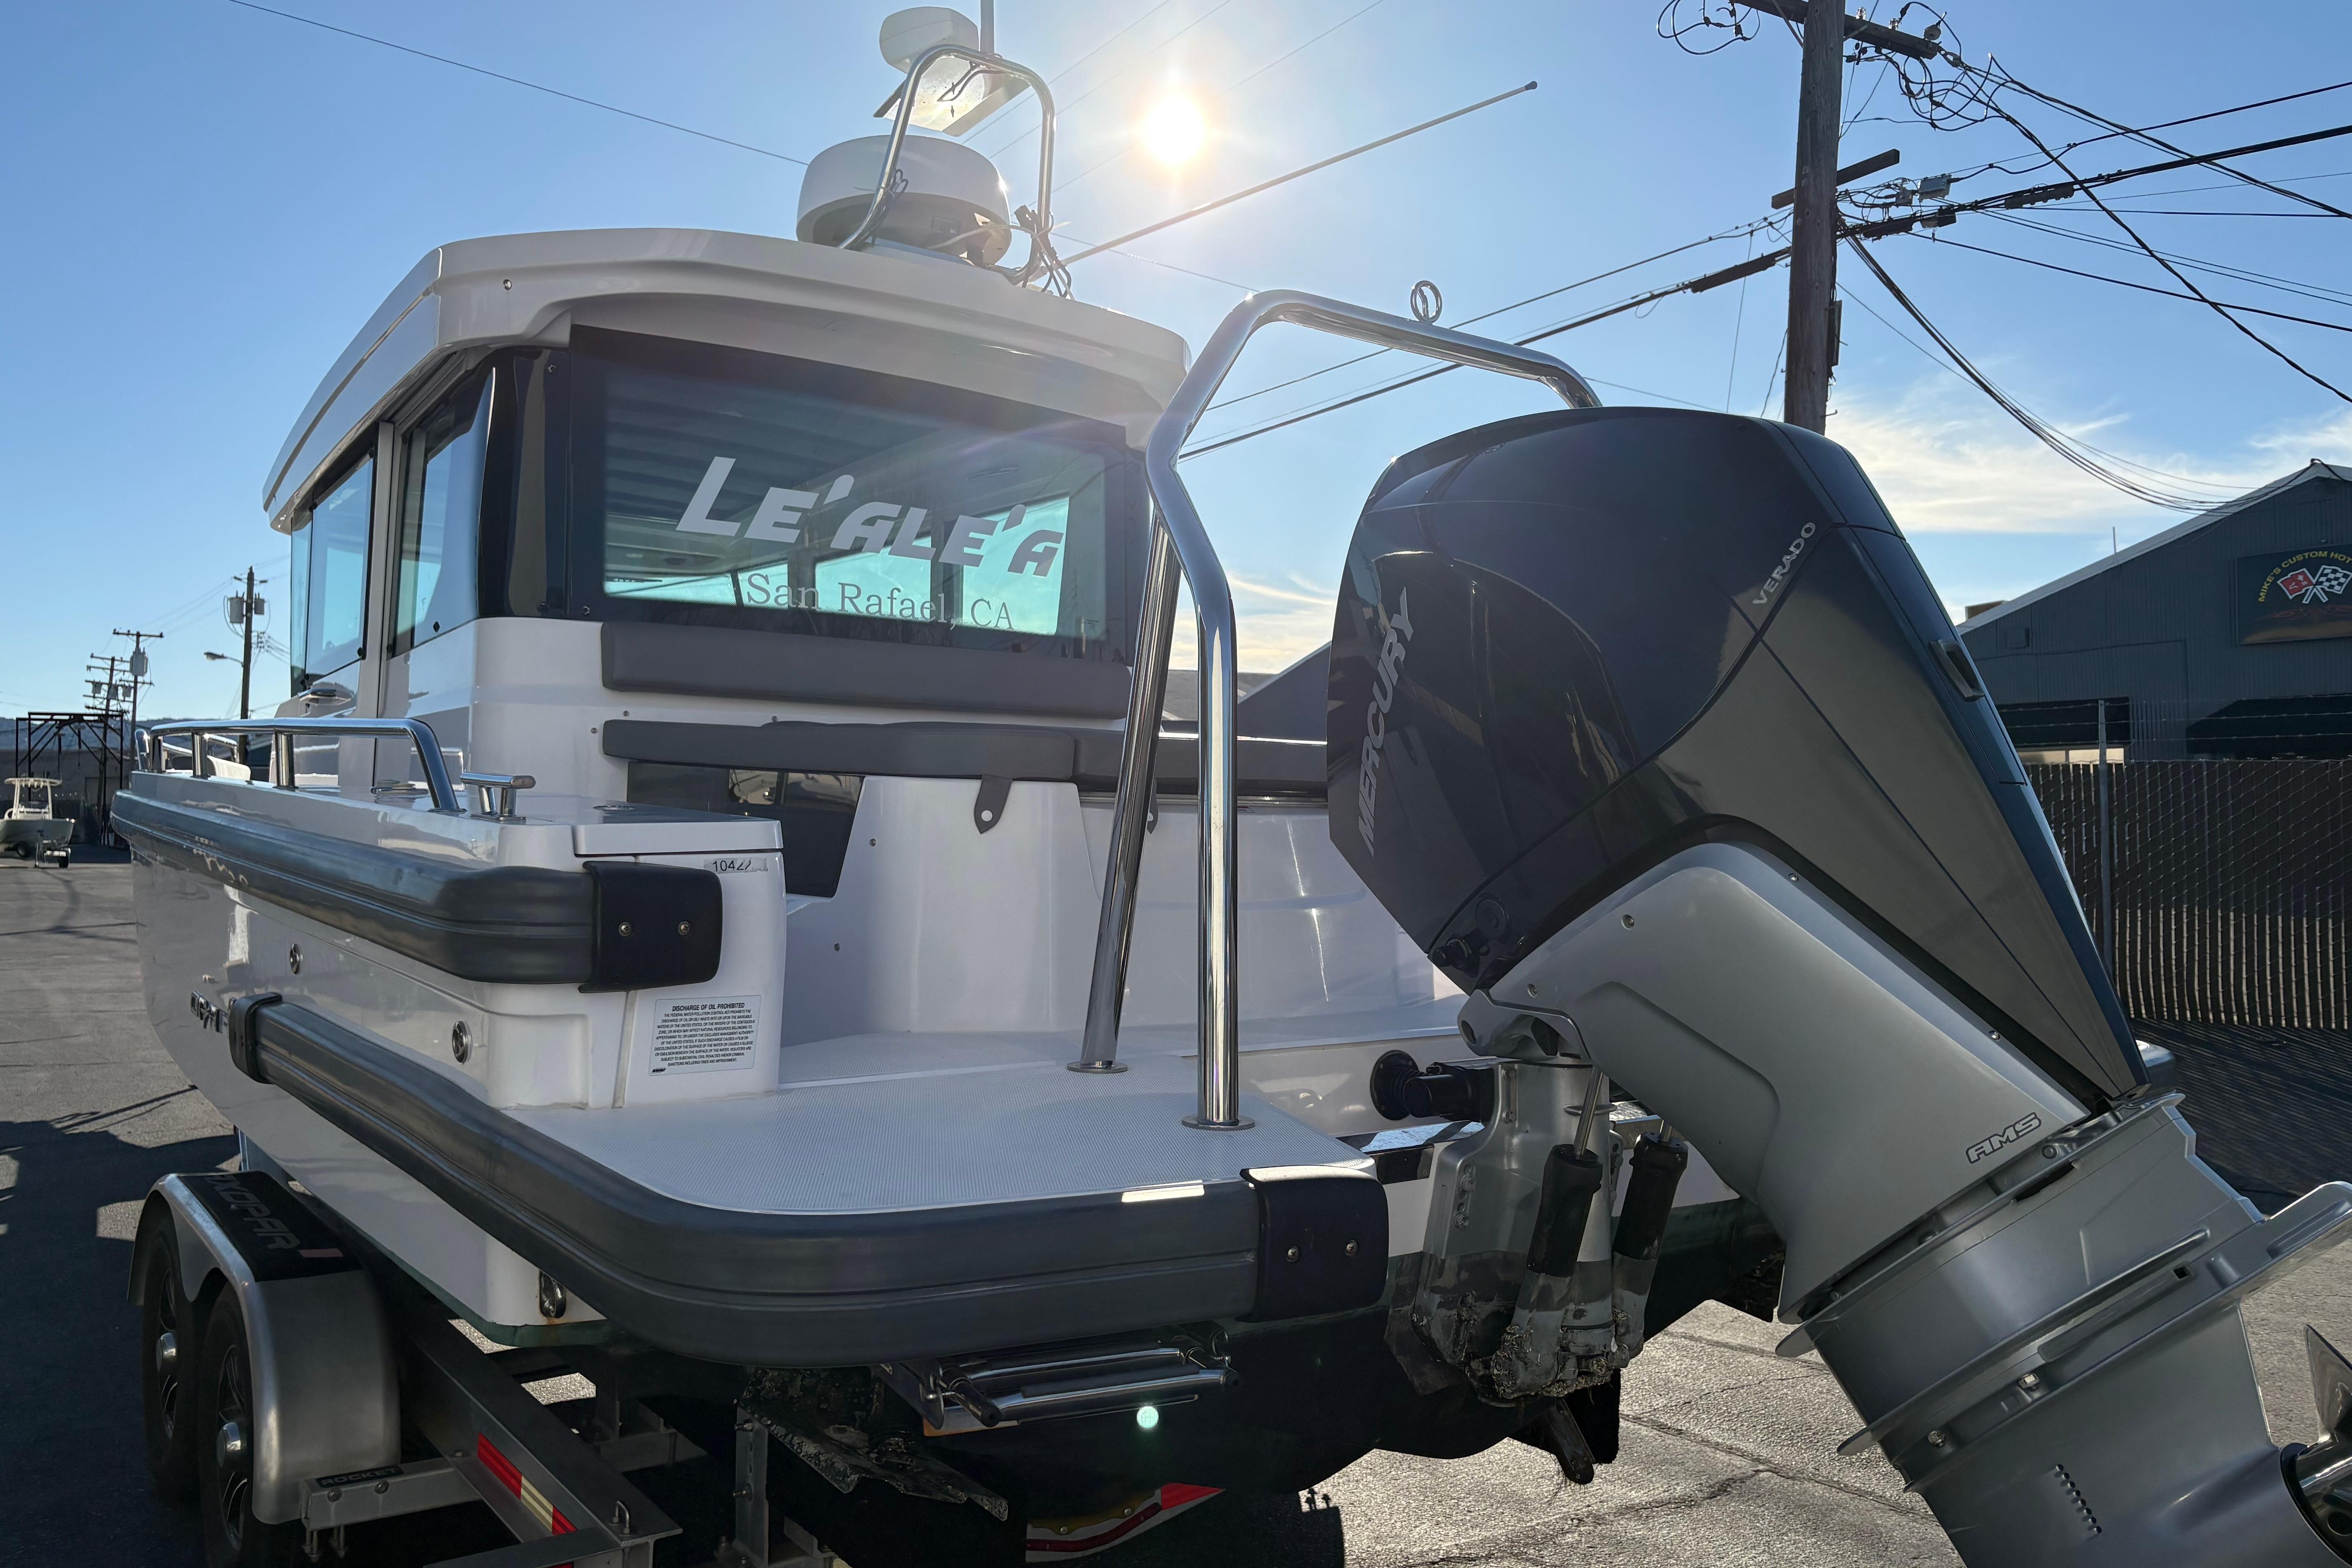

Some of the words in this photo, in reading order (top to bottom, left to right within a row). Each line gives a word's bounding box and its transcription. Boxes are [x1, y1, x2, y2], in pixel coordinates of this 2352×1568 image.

[1752, 522, 1816, 604] VERADO
[2259, 567, 2282, 602] MIKE'S
[2282, 551, 2329, 568] CUSTOM
[747, 572, 820, 611] San
[838, 581, 958, 631] Rafael,
[970, 598, 1015, 630] CA
[1358, 587, 1413, 858] MERCURY
[1965, 1112, 2042, 1164] AMS
